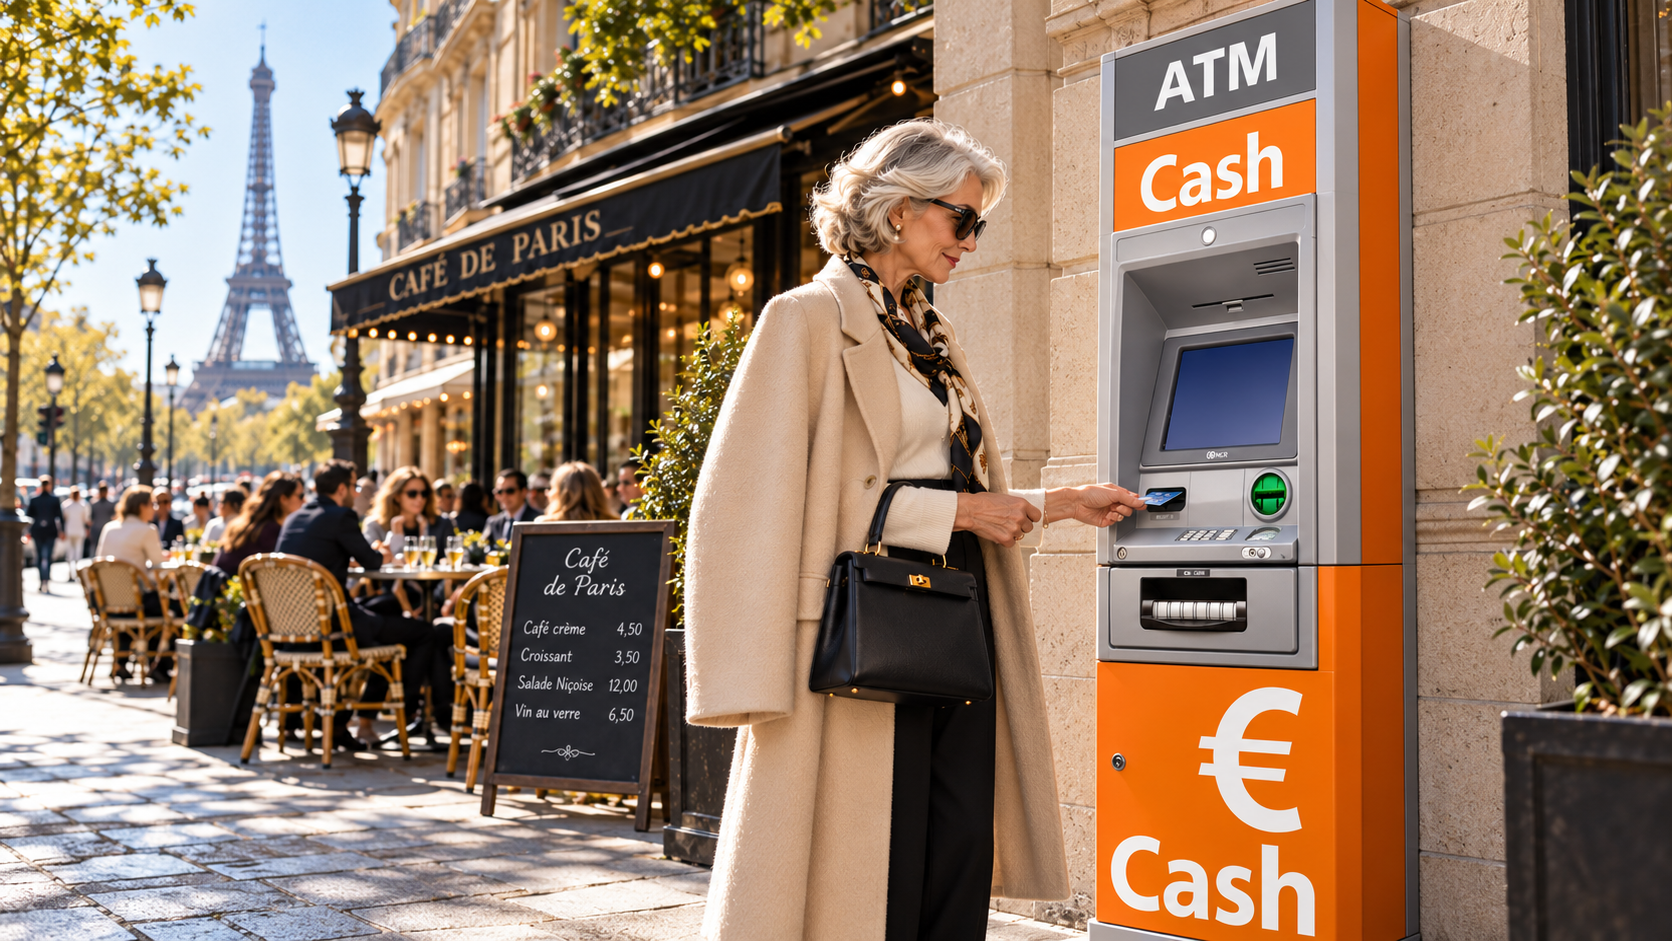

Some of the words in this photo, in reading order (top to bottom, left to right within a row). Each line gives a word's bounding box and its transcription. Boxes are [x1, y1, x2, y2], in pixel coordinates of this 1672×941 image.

[1154, 32, 1277, 112] ATM
[1140, 130, 1284, 213] Cash
[389, 252, 449, 301] CAFÉ
[459, 242, 497, 280] DE
[512, 210, 602, 264] PARIS
[565, 547, 609, 574] Café
[544, 575, 565, 595] de
[575, 573, 625, 596] Paris
[524, 620, 549, 638] Café
[553, 623, 585, 635] crème
[617, 623, 642, 636] 4,50
[521, 648, 572, 662] Croissant
[615, 651, 639, 665] 3,50
[518, 675, 552, 689] Salade
[557, 677, 593, 694] Niçoise
[609, 679, 637, 693] 12,00
[516, 704, 531, 717] Vin
[536, 709, 549, 718] au
[554, 710, 580, 719] verre
[609, 708, 634, 723] 6,50
[1198, 687, 1302, 832] €
[1110, 836, 1315, 938] Cash
